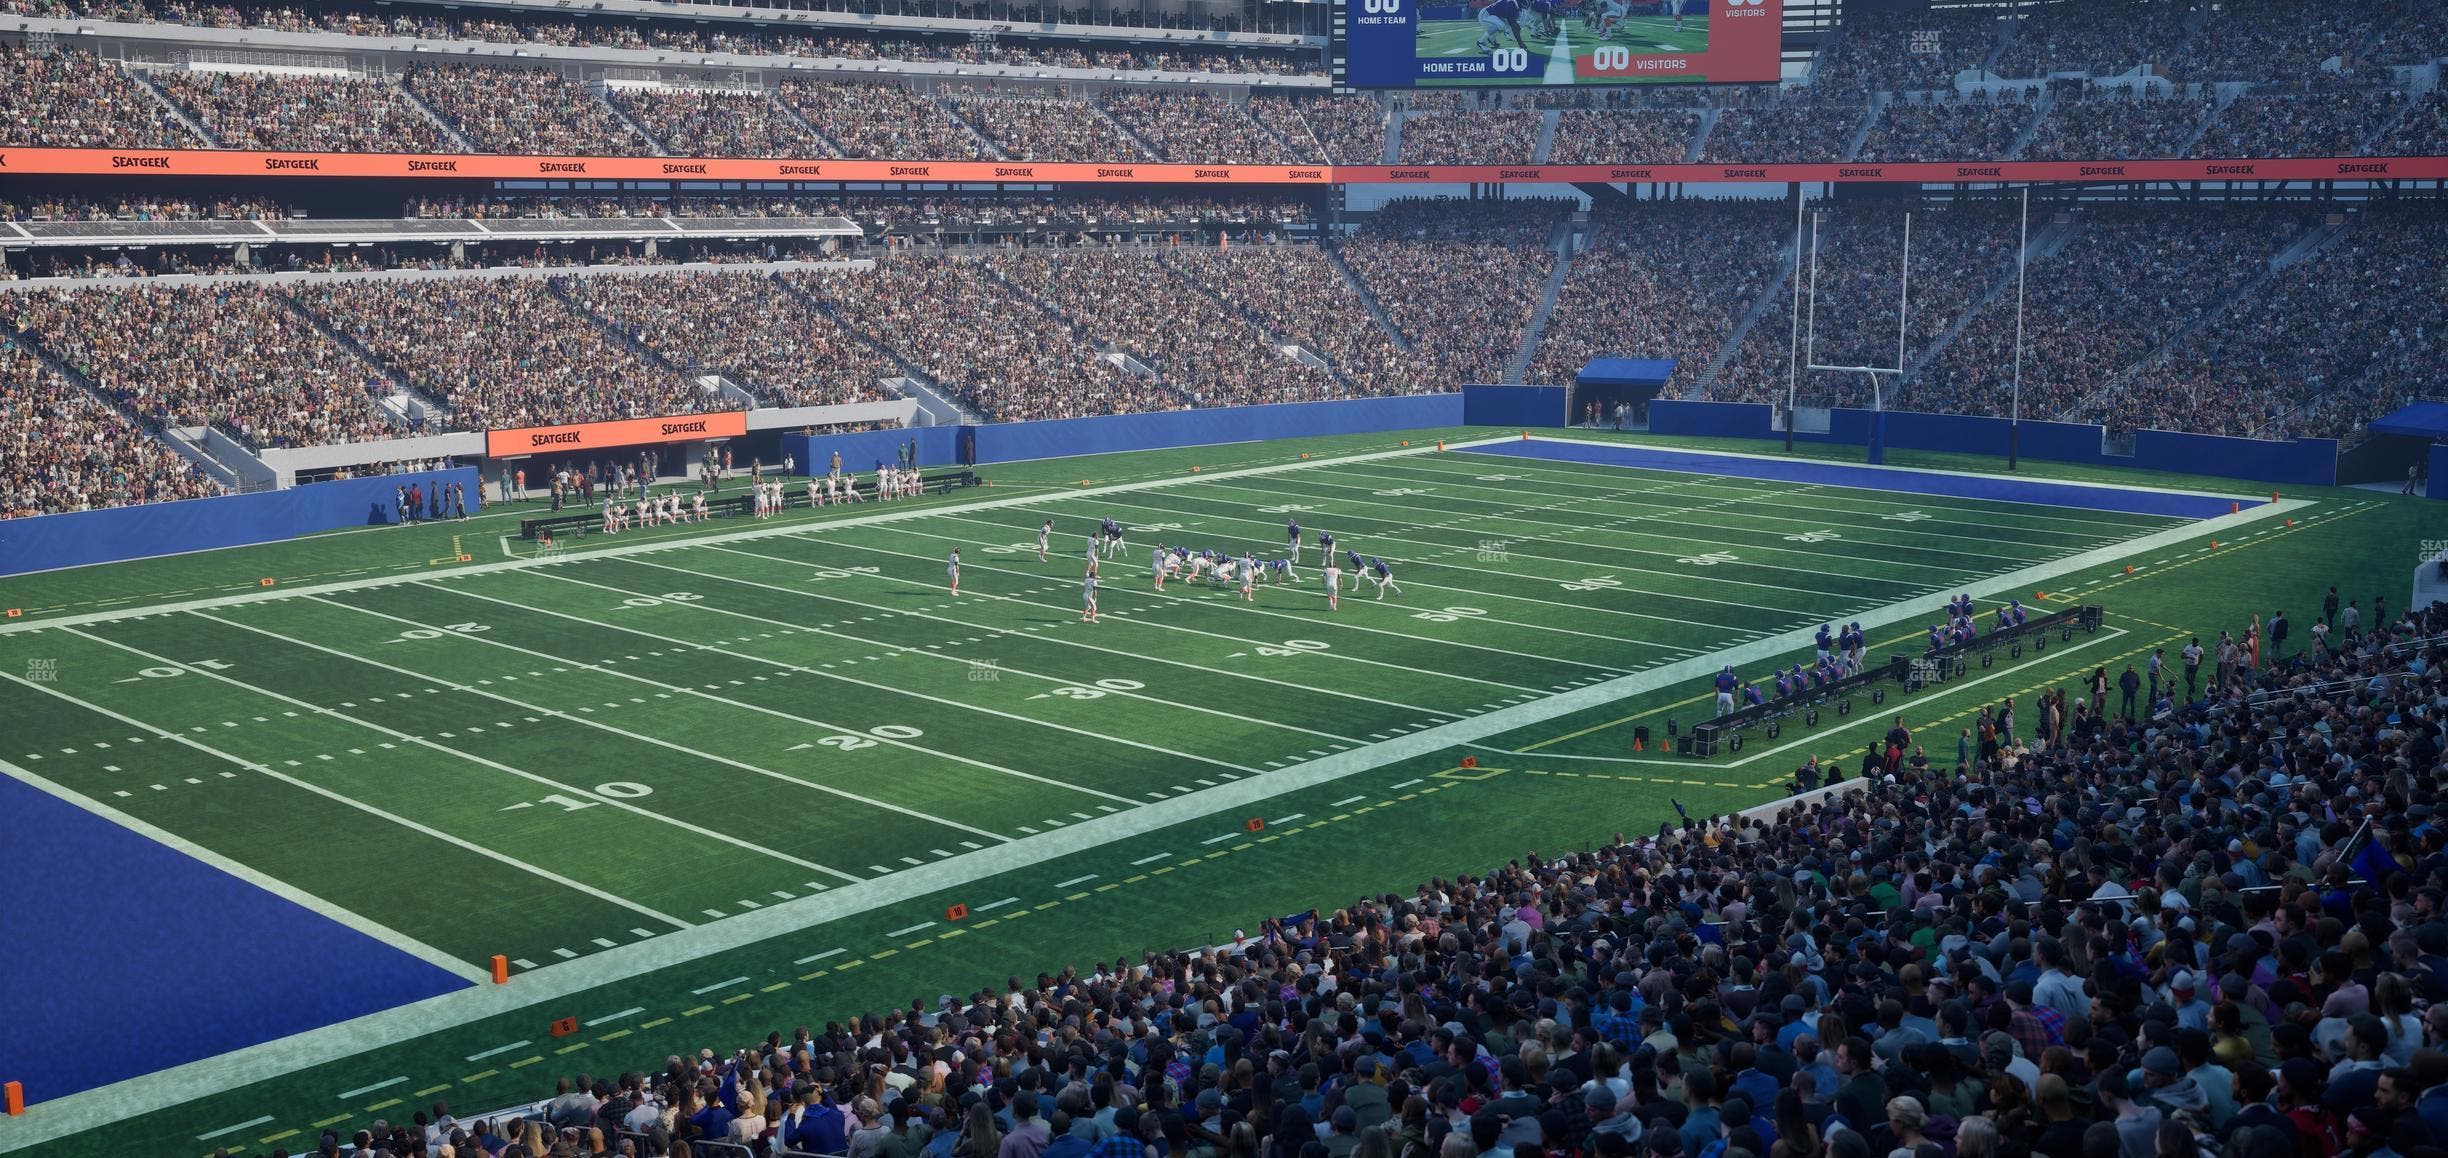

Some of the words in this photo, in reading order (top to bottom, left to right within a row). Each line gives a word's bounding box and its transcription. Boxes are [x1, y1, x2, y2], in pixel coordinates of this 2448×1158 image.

[1725, 9, 1765, 18] VISITORS
[1358, 17, 1382, 25] HOME
[1384, 16, 1406, 24] TEAM
[1423, 63, 1453, 73] HOME
[1455, 62, 1486, 73] TEAM
[1492, 48, 1528, 72] 00
[1593, 46, 1629, 71] 00
[1636, 59, 1687, 70] VISITORS
[112, 155, 171, 169] SEATGEEK
[266, 158, 319, 171] SEATGEEK
[408, 160, 457, 172] SEATGEEK
[540, 161, 586, 174] SEATGEEK
[2338, 162, 2388, 174] SEATGEEK
[663, 163, 707, 175] SEATGEEK
[780, 165, 820, 176] SEATGEEK
[891, 166, 930, 177] SEATGEEK
[995, 167, 1033, 177] SEATGEEK
[1098, 168, 1134, 178] SEATGEEK
[1195, 169, 1230, 179] SEATGEEK
[1289, 170, 1322, 179] SEATGEEK
[1391, 170, 1430, 179] SEATGEEK
[1500, 170, 1540, 179] SEATGEEK
[1611, 169, 1652, 179] SEATGEEK
[1724, 168, 1766, 179] SEATGEEK
[1839, 168, 1882, 178] SEATGEEK
[1957, 167, 2001, 177] SEATGEEK
[2080, 166, 2125, 177] SEATGEEK
[2207, 164, 2255, 176] SEATGEEK
[661, 420, 707, 436] SEATGEEK
[531, 430, 581, 447] SEATGEEK
[1675, 553, 1739, 566] 30
[1559, 578, 1623, 591] 40
[622, 591, 705, 607] 30
[1410, 606, 1488, 622] 50
[400, 622, 492, 639] 20
[1255, 639, 1331, 657] 40
[138, 659, 236, 678] 10
[1052, 678, 1146, 700] 30
[817, 725, 924, 751] 20
[538, 781, 654, 812] 10
[953, 906, 963, 917] 10
